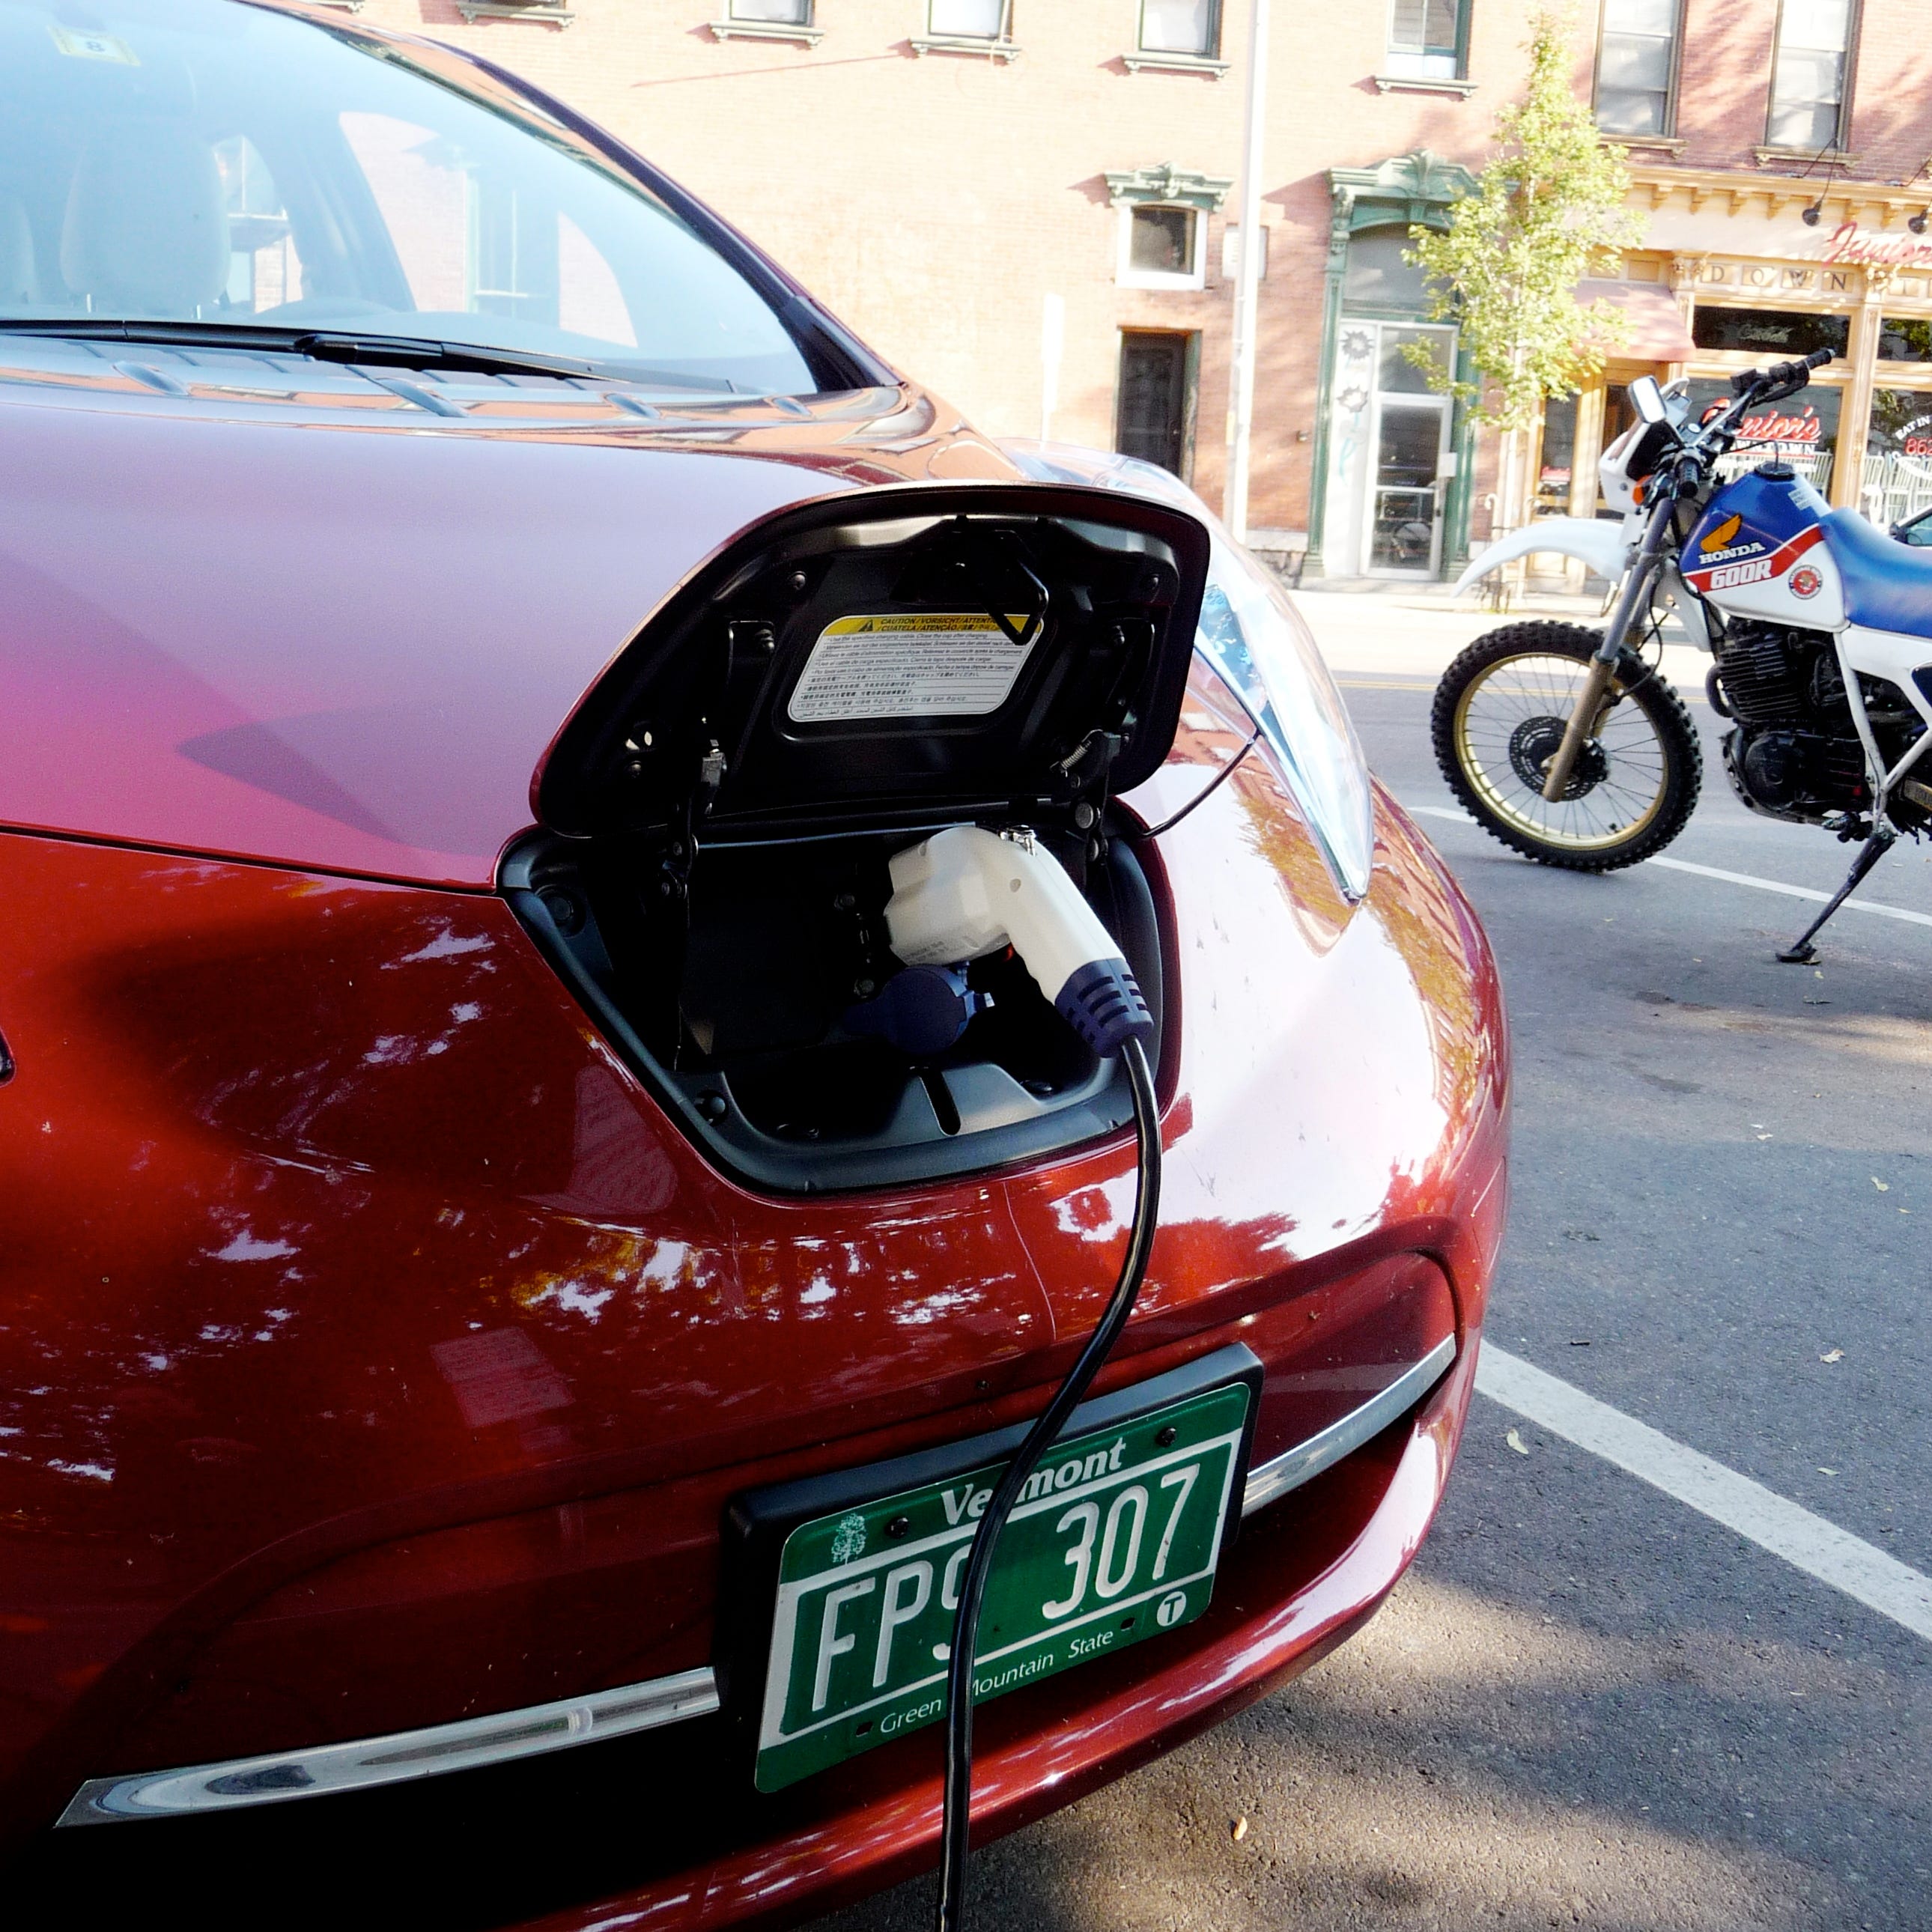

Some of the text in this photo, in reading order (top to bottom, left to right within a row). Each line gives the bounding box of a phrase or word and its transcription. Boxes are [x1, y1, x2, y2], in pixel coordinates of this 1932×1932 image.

[1895, 415, 1931, 440] EAT IN
[1699, 542, 1766, 565] HONDA
[1710, 559, 1772, 589] 600R
[941, 1439, 1126, 1526] Vemont
[1042, 1462, 1200, 1620] 307
[879, 1698, 942, 1734] Green
[1067, 1629, 1114, 1659] State
